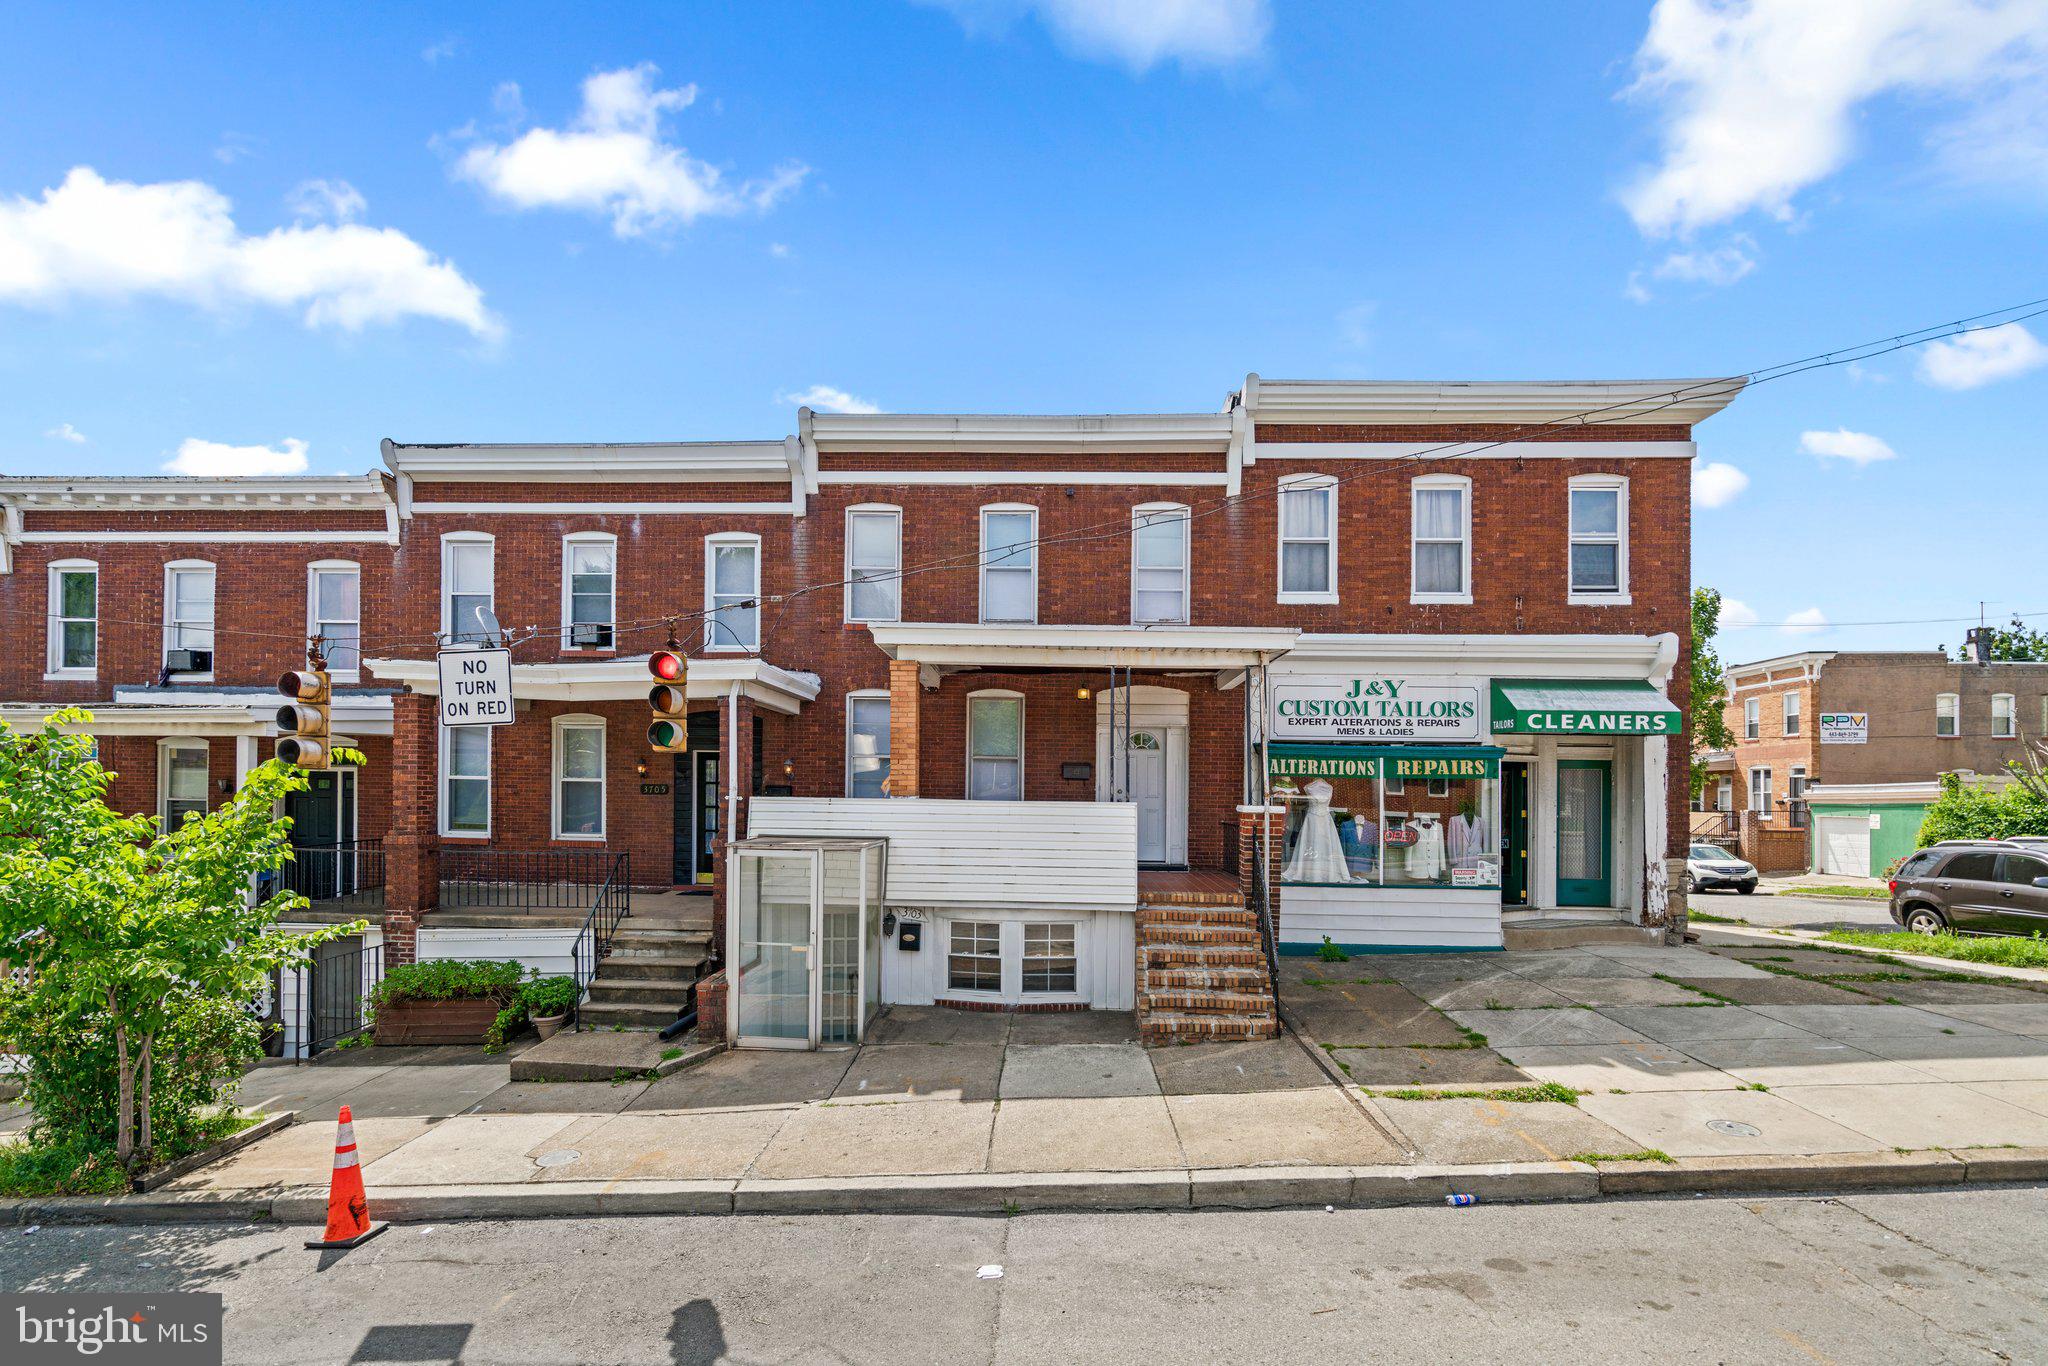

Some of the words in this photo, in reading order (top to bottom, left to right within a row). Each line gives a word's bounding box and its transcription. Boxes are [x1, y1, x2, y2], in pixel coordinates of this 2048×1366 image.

[463, 660, 487, 674] NO
[455, 680, 496, 695] TURN
[1345, 679, 1406, 699] J&Y
[448, 702, 469, 716] ON
[477, 701, 507, 715] RED
[1278, 699, 1369, 717] CUSTOM
[1374, 700, 1475, 718] TAILORS
[1288, 717, 1327, 726] EXPERT
[1331, 718, 1401, 727] ALTERATIONS
[1405, 719, 1414, 727] &
[1417, 719, 1460, 727] REPAIRS
[1493, 719, 1514, 730] TAILORS
[1527, 713, 1667, 730] CLEANERS
[1821, 715, 1865, 726] RPM
[1368, 728, 1376, 736] &
[1379, 728, 1415, 736] LADIES
[1269, 758, 1375, 776] ALTERATIONS
[1396, 759, 1485, 776] REPAIRS
[642, 785, 666, 793] 3705
[1384, 829, 1417, 842] OPEN
[902, 909, 922, 919] 3703
